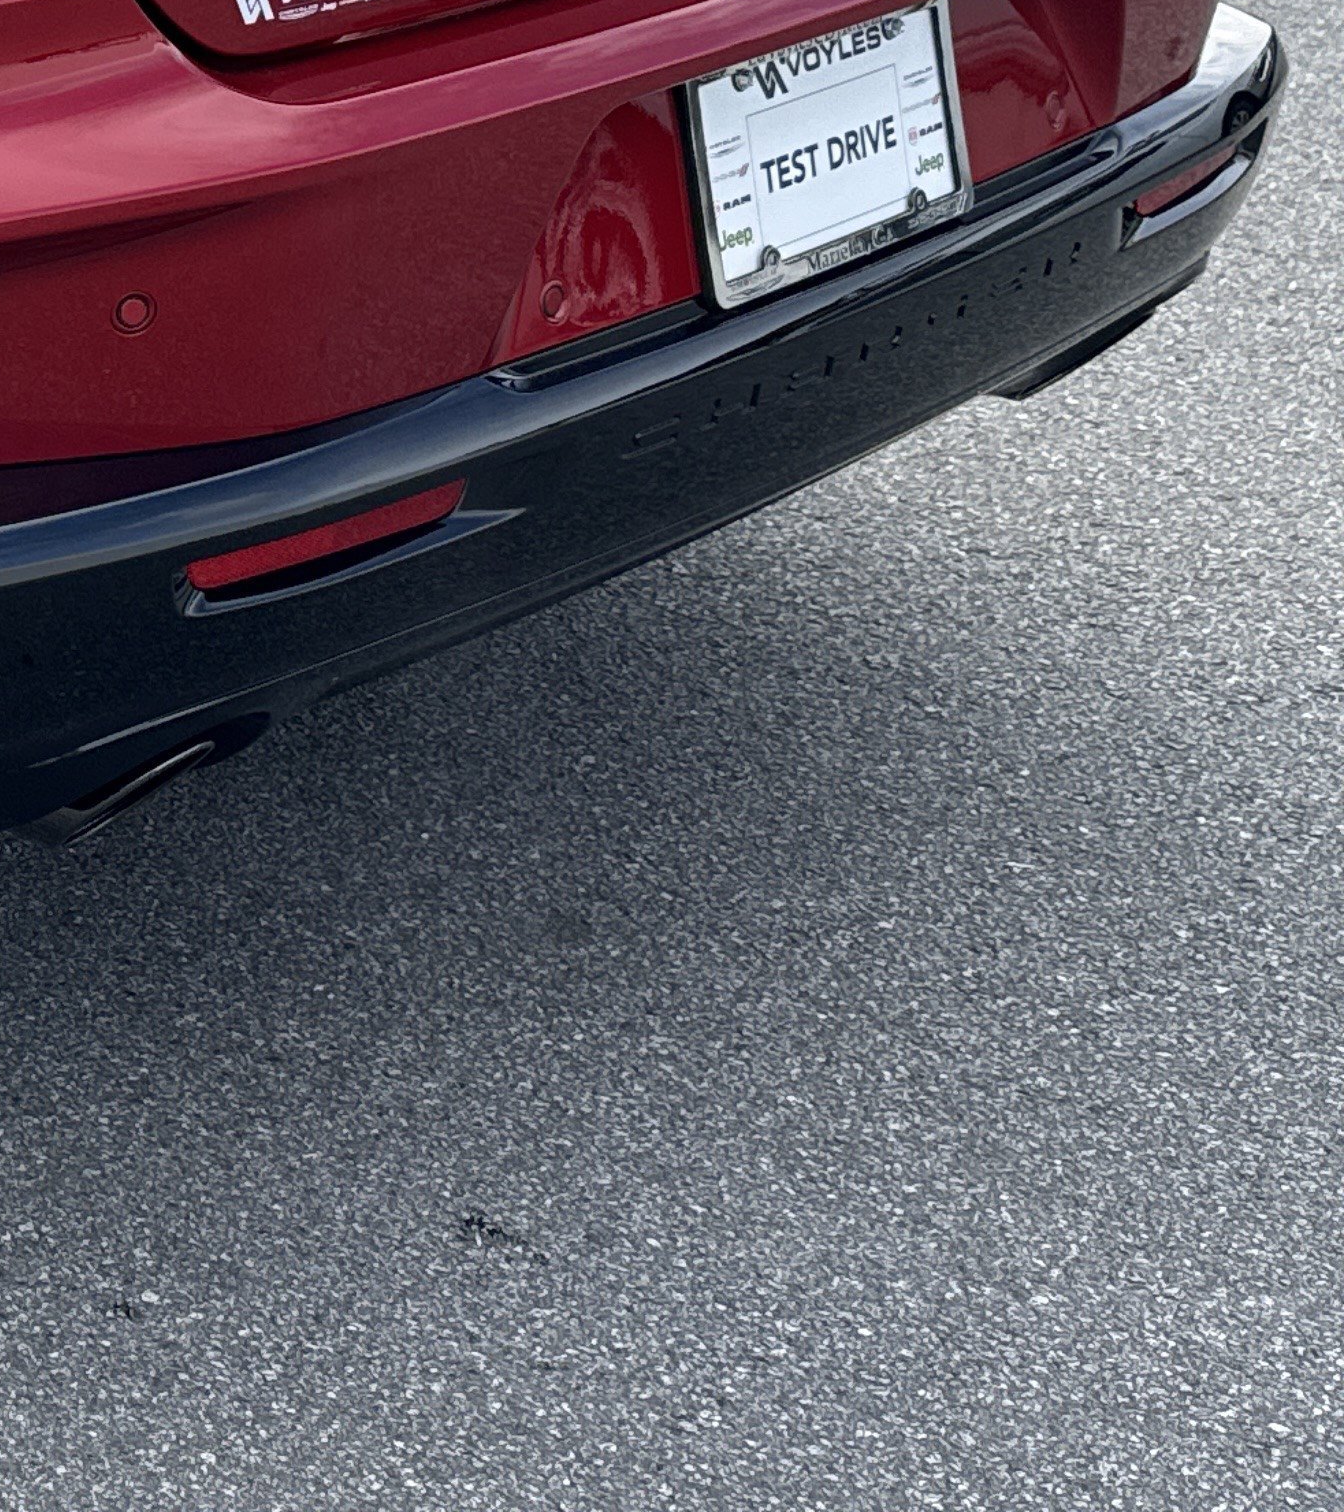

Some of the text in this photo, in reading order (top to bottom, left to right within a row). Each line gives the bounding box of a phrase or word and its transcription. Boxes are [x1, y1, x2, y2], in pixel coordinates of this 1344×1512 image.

[787, 26, 881, 76] VOYLES
[919, 122, 943, 137] RAM
[760, 115, 897, 193] TEST DRIVE
[915, 152, 945, 176] Jeep
[723, 194, 752, 211] RAM
[720, 226, 754, 252] Jeep
